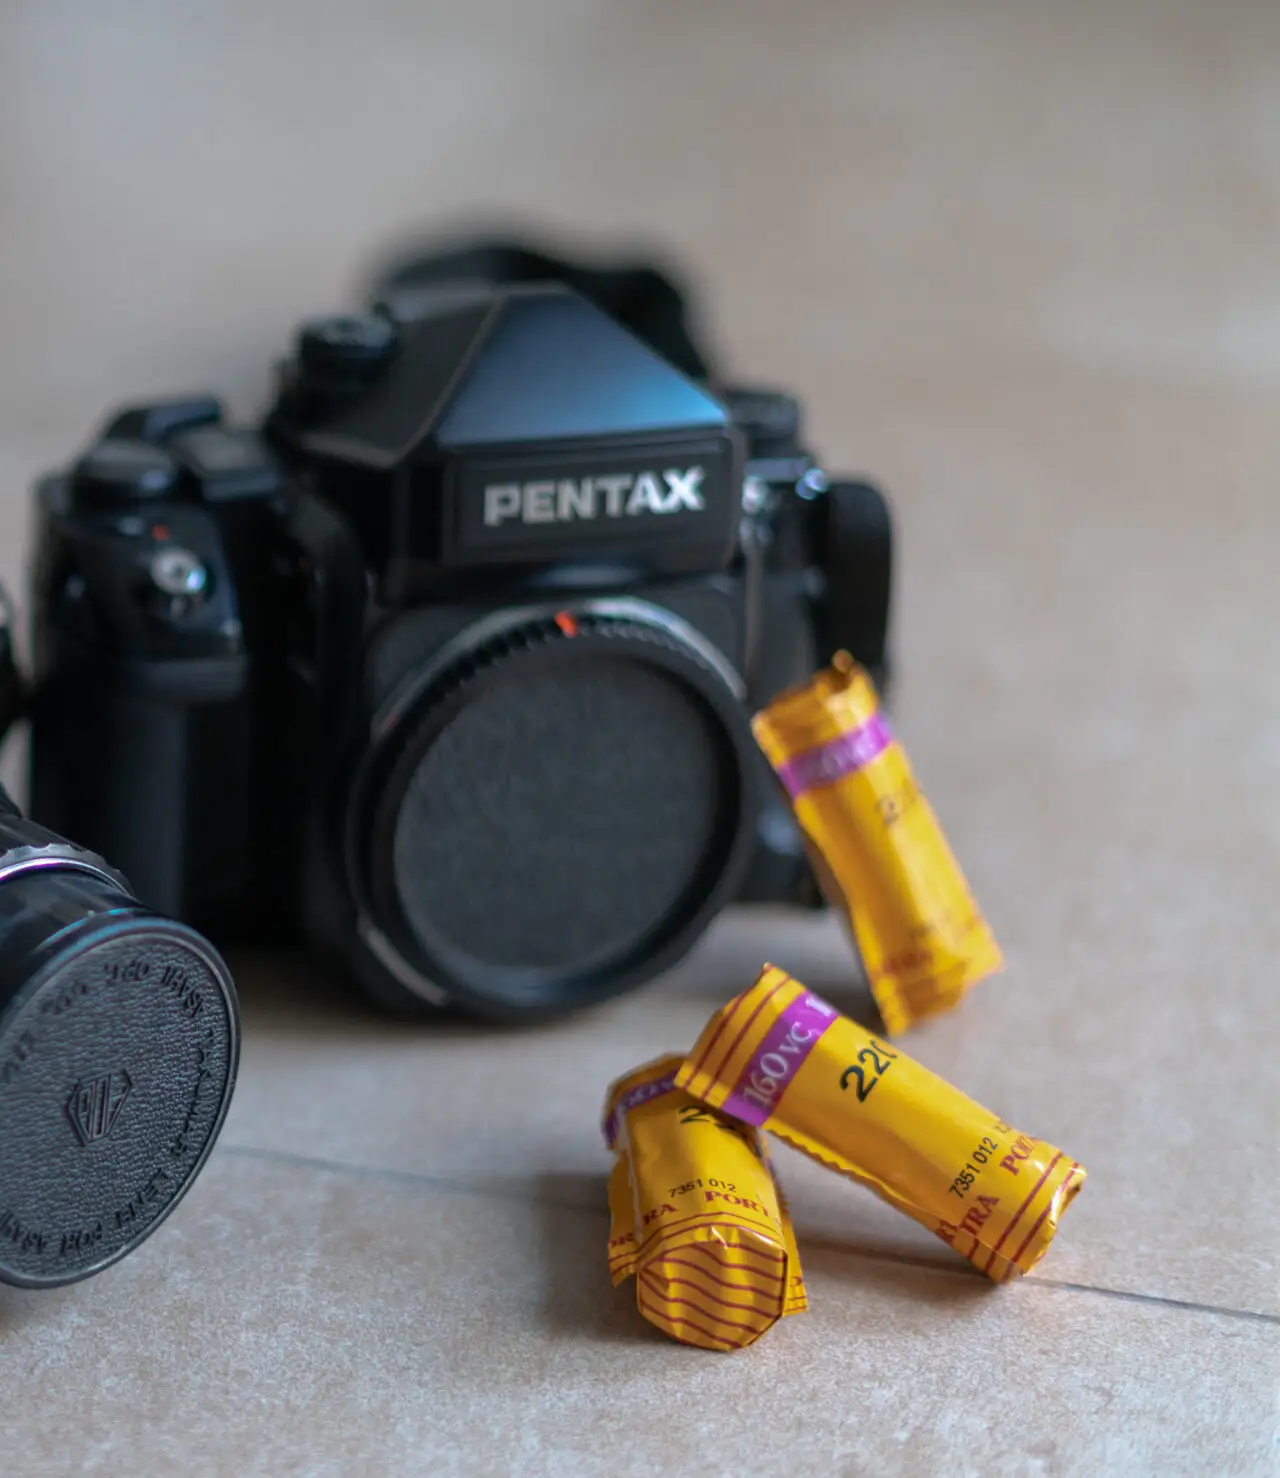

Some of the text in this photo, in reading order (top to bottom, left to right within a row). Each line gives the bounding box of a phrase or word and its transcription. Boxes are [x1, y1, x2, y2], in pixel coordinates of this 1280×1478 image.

[483, 466, 706, 527] PENTAX
[743, 1052, 788, 1109] 160
[668, 1178, 736, 1198] 7351 012
[948, 1136, 998, 1198] 7351 012
